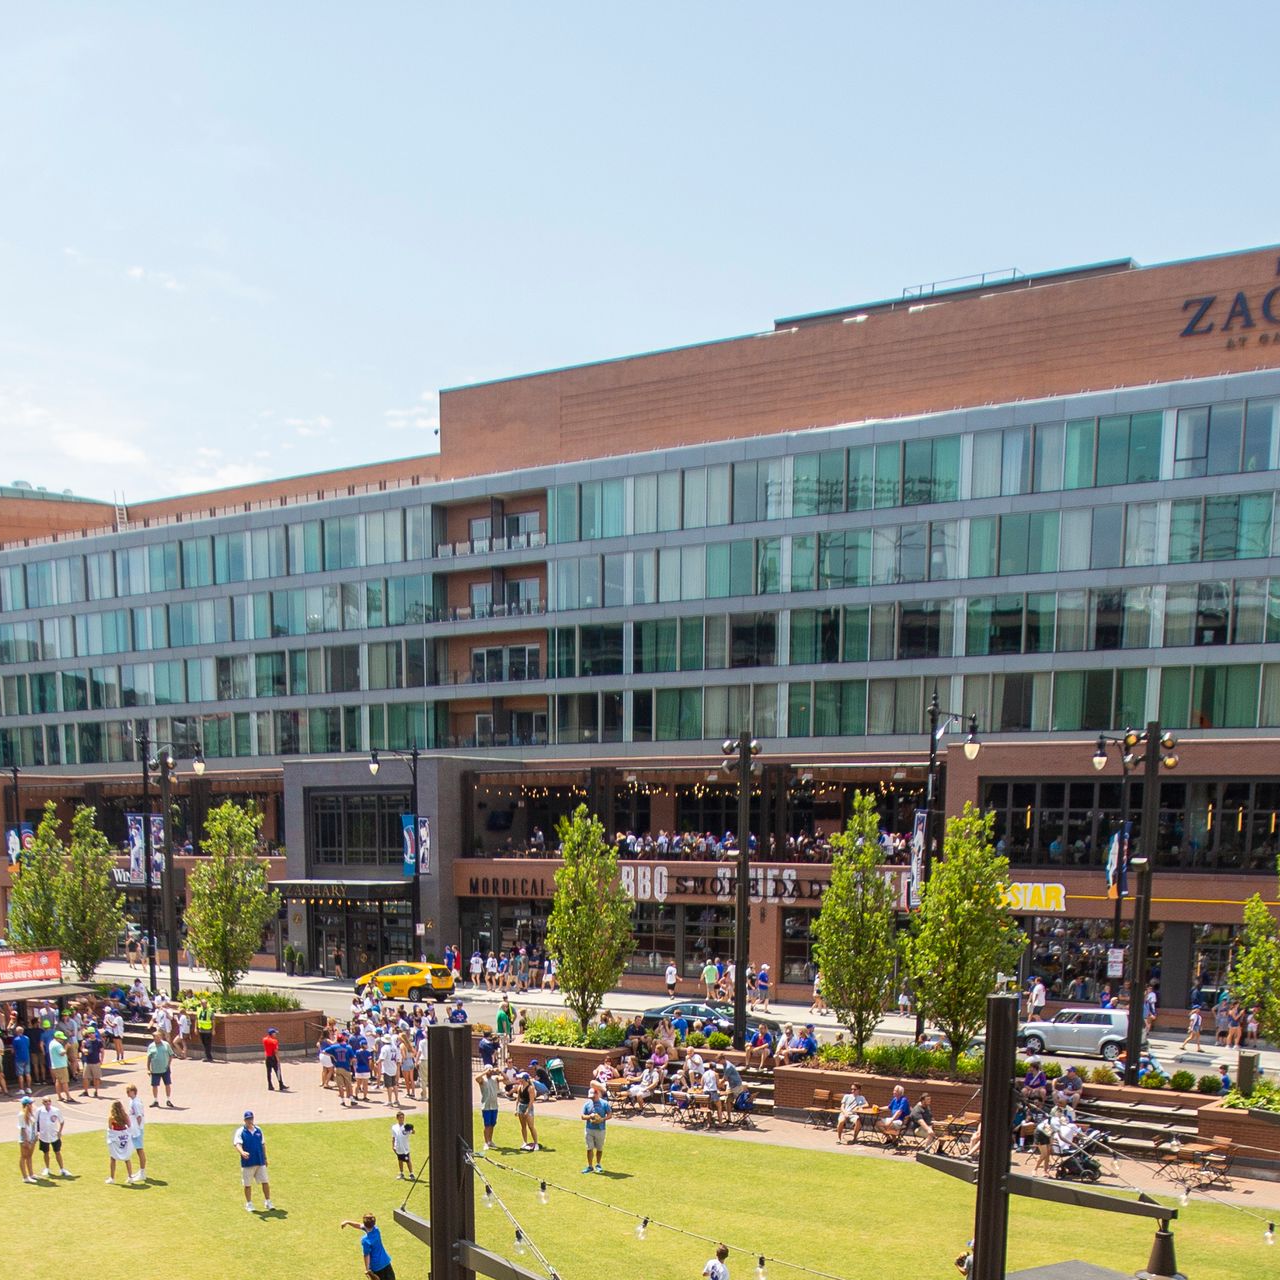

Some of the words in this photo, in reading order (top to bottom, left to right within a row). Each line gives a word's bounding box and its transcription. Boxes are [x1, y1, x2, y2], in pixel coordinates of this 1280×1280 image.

[286, 884, 347, 897] ZACHARY
[469, 876, 545, 896] MORDECAI
[621, 865, 669, 902] BBQ
[1011, 882, 1066, 911] STAR
[0, 972, 14, 980] THIS
[33, 969, 45, 978] FOR
